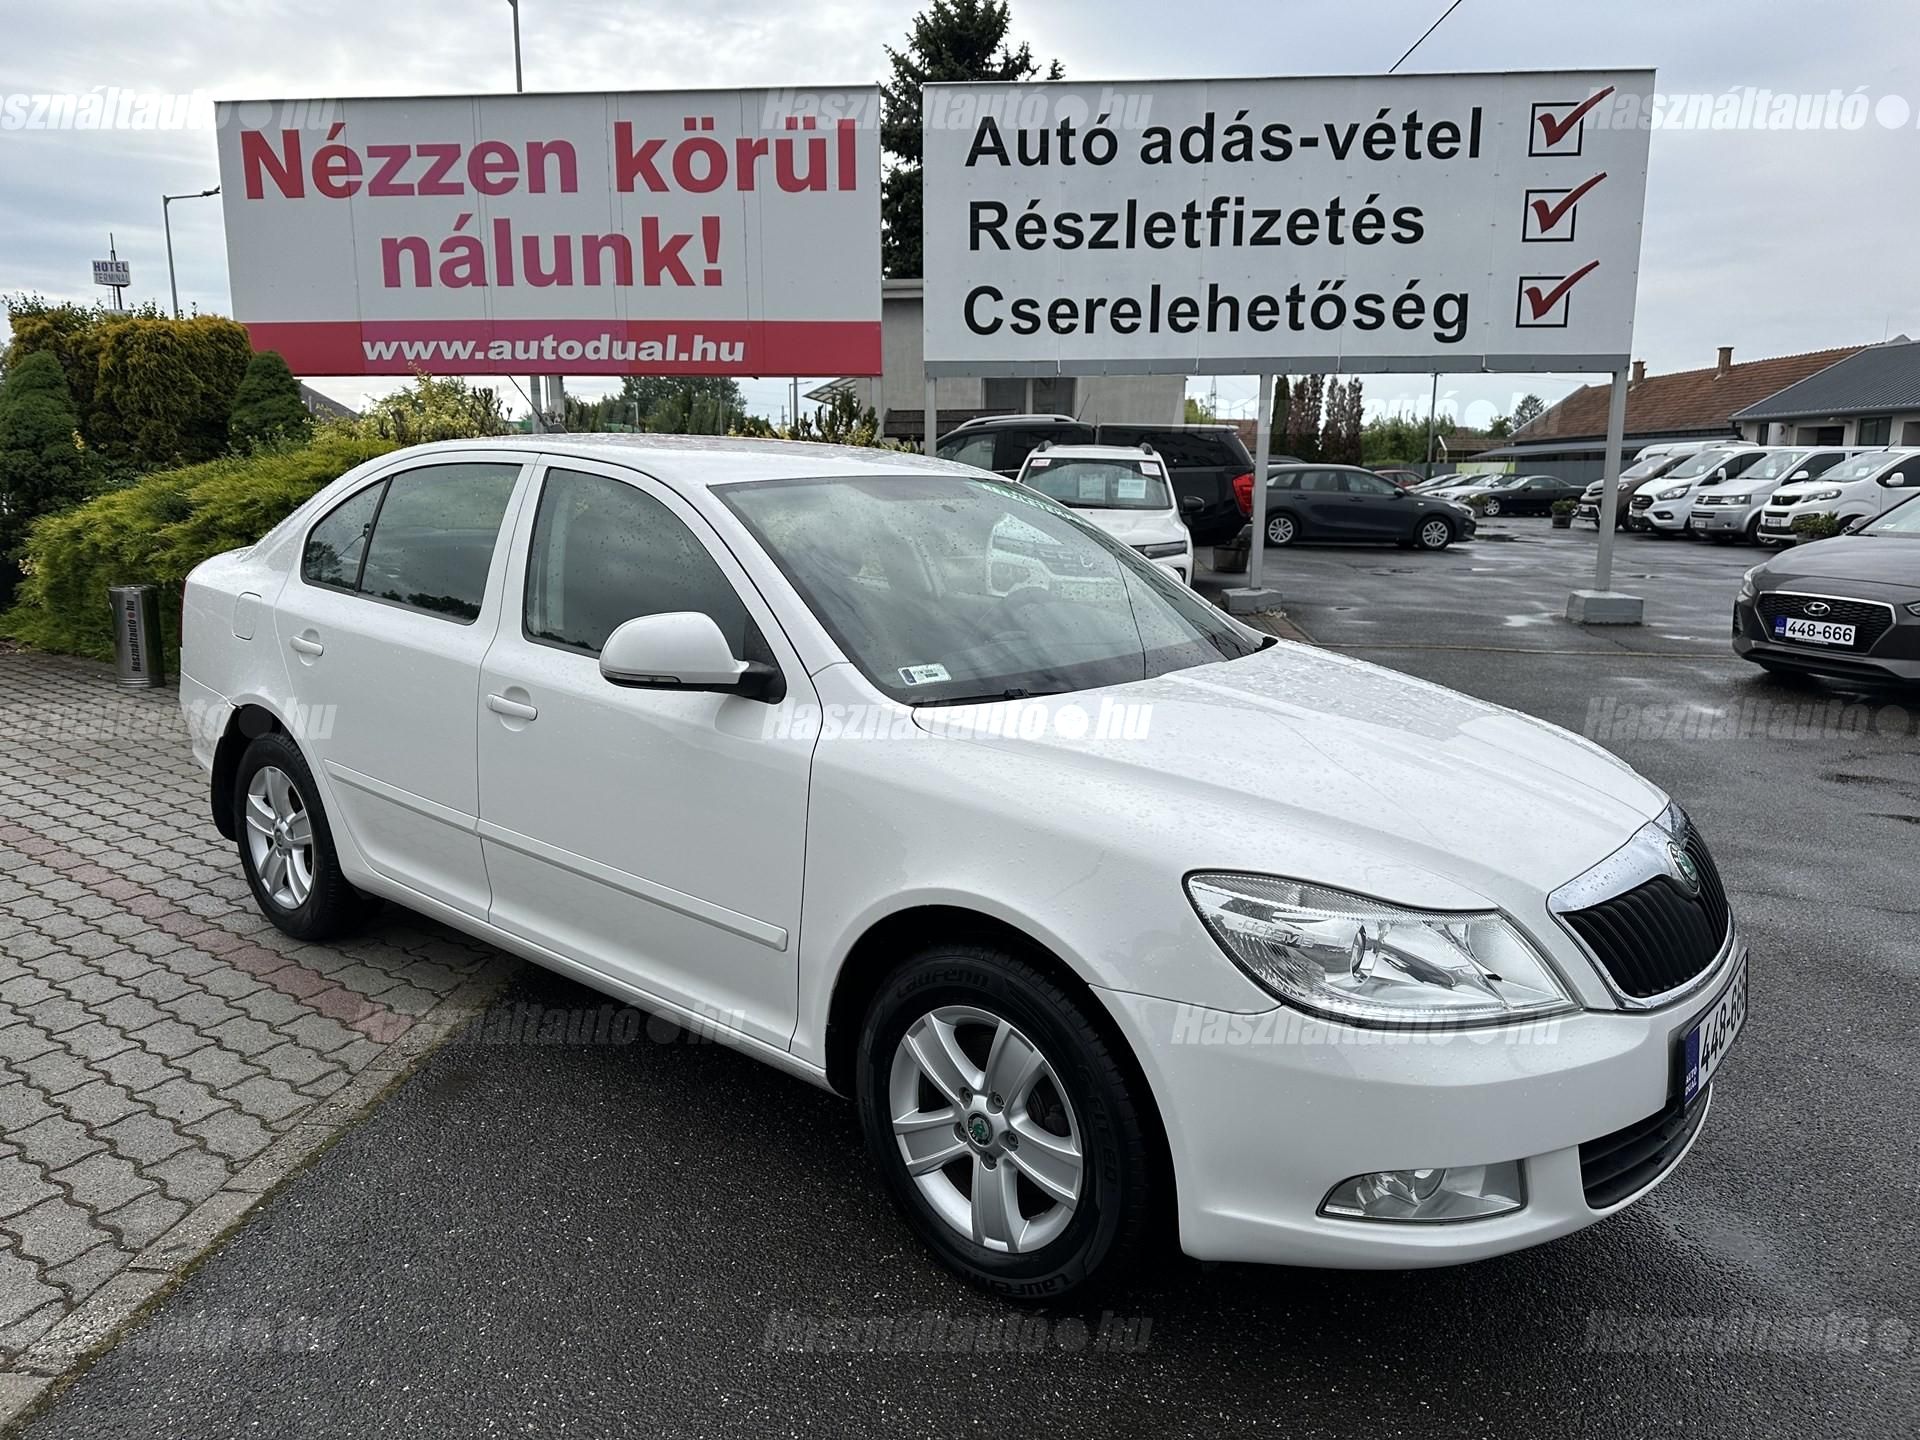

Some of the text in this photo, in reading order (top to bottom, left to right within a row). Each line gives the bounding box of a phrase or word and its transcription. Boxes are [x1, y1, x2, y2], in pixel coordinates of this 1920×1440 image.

[243, 117, 856, 199] Nézzen körül
[965, 106, 1483, 167] Autó adás-vétel
[383, 214, 722, 288] nálunk!
[969, 193, 1425, 251] Részletfizetés
[94, 262, 129, 272] HOTEL
[94, 272, 130, 283] TERMINAL
[963, 279, 1469, 343] Cserelehetőség
[363, 334, 745, 364] www.autodual.hu
[1787, 620, 1853, 642] 448-666
[1701, 964, 1747, 1073] 448-666
